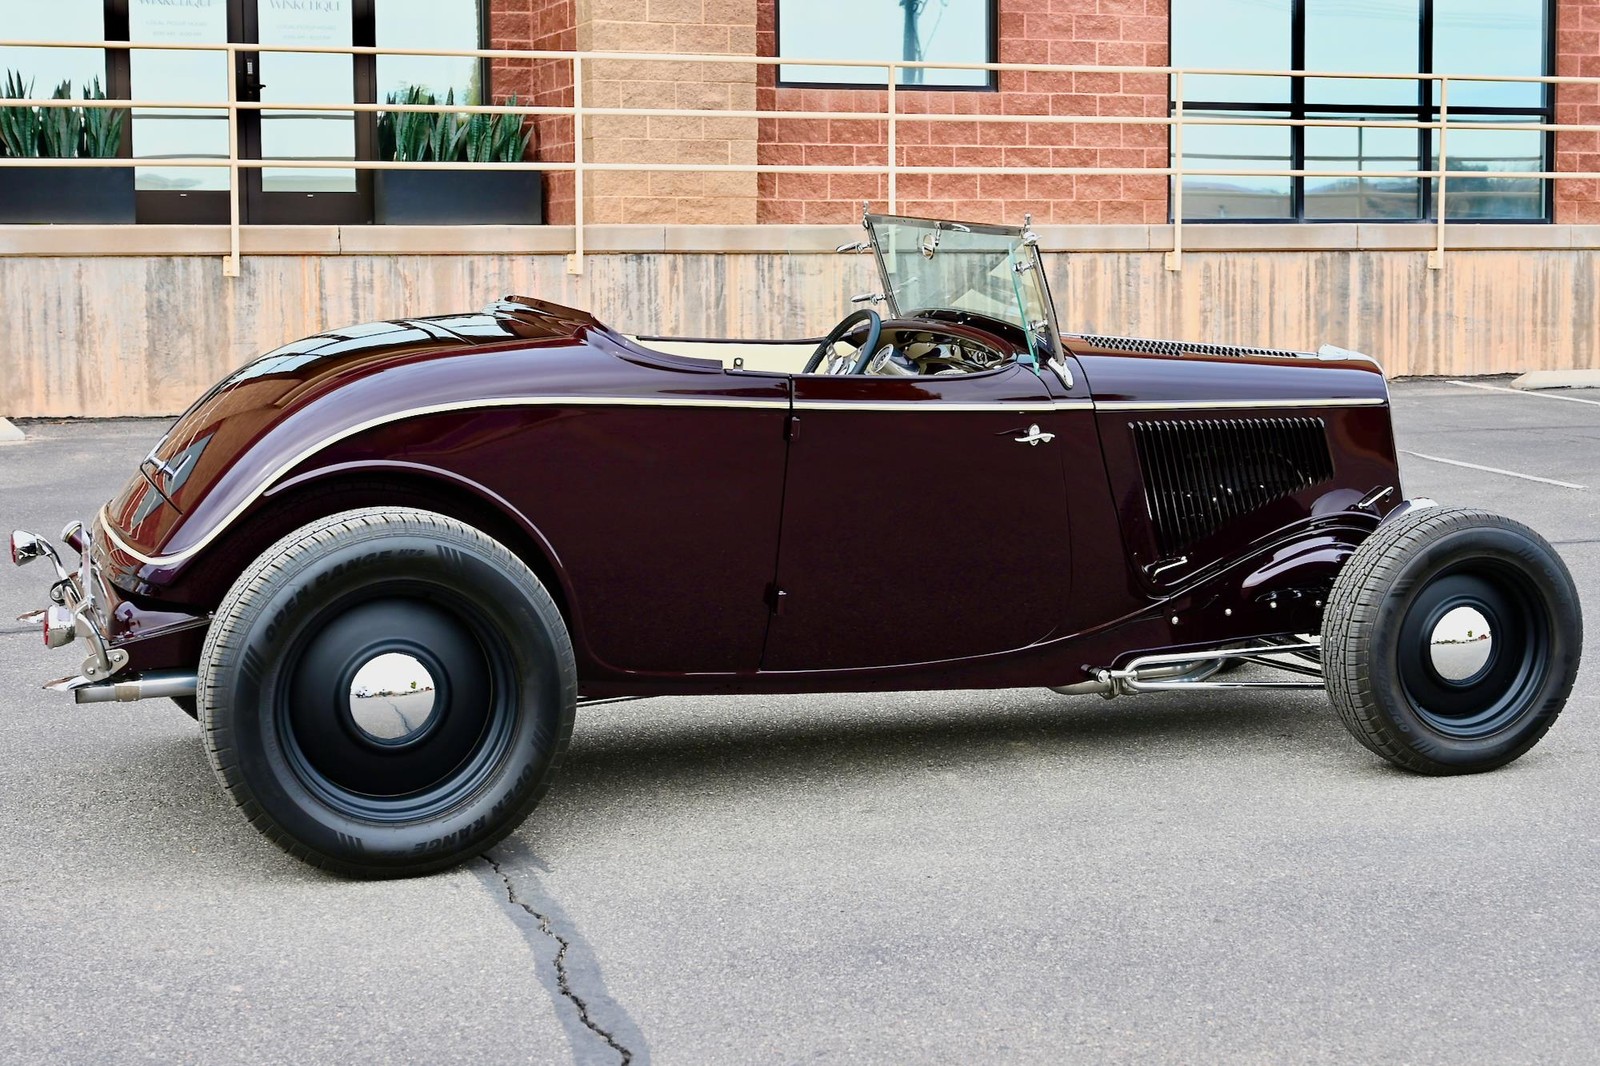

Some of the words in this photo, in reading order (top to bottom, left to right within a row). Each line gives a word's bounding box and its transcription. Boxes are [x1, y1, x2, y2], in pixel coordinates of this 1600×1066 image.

[265, 585, 308, 642] OPEN
[316, 549, 393, 587] RANGE
[413, 814, 487, 854] RANGE
